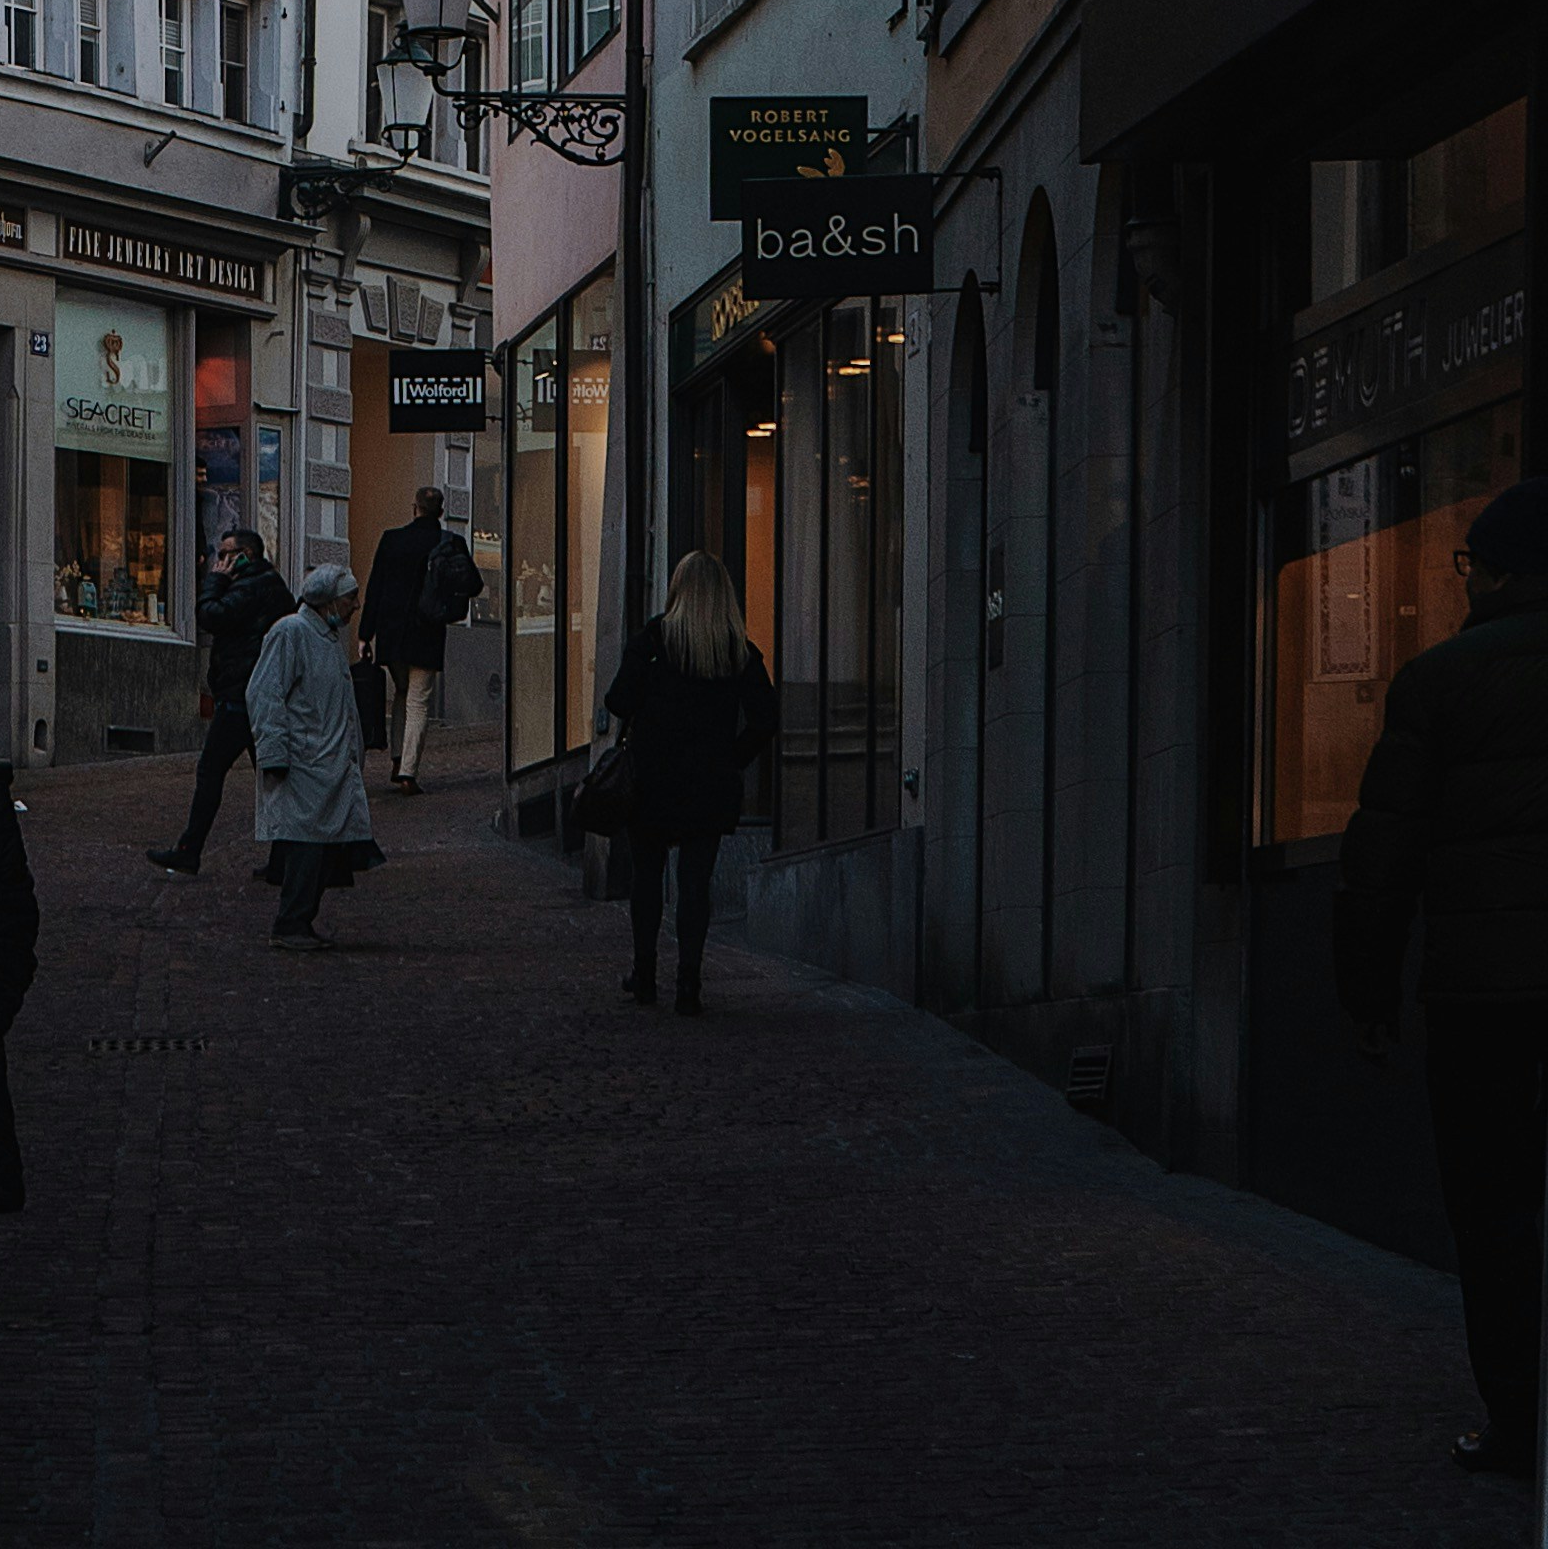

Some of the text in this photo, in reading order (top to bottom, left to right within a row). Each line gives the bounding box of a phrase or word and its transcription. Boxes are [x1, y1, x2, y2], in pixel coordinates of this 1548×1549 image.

[750, 109, 829, 125] ROBERT
[729, 129, 851, 143] VOGELSANG
[756, 212, 919, 260] ba&sh
[68, 226, 256, 292] FINE JEWELRY ART DESIGN
[33, 333, 47, 353] 23
[1288, 289, 1525, 439] DEMUTH JUWELIER
[408, 383, 467, 399] Wolford
[66, 397, 158, 430] SEACRET
